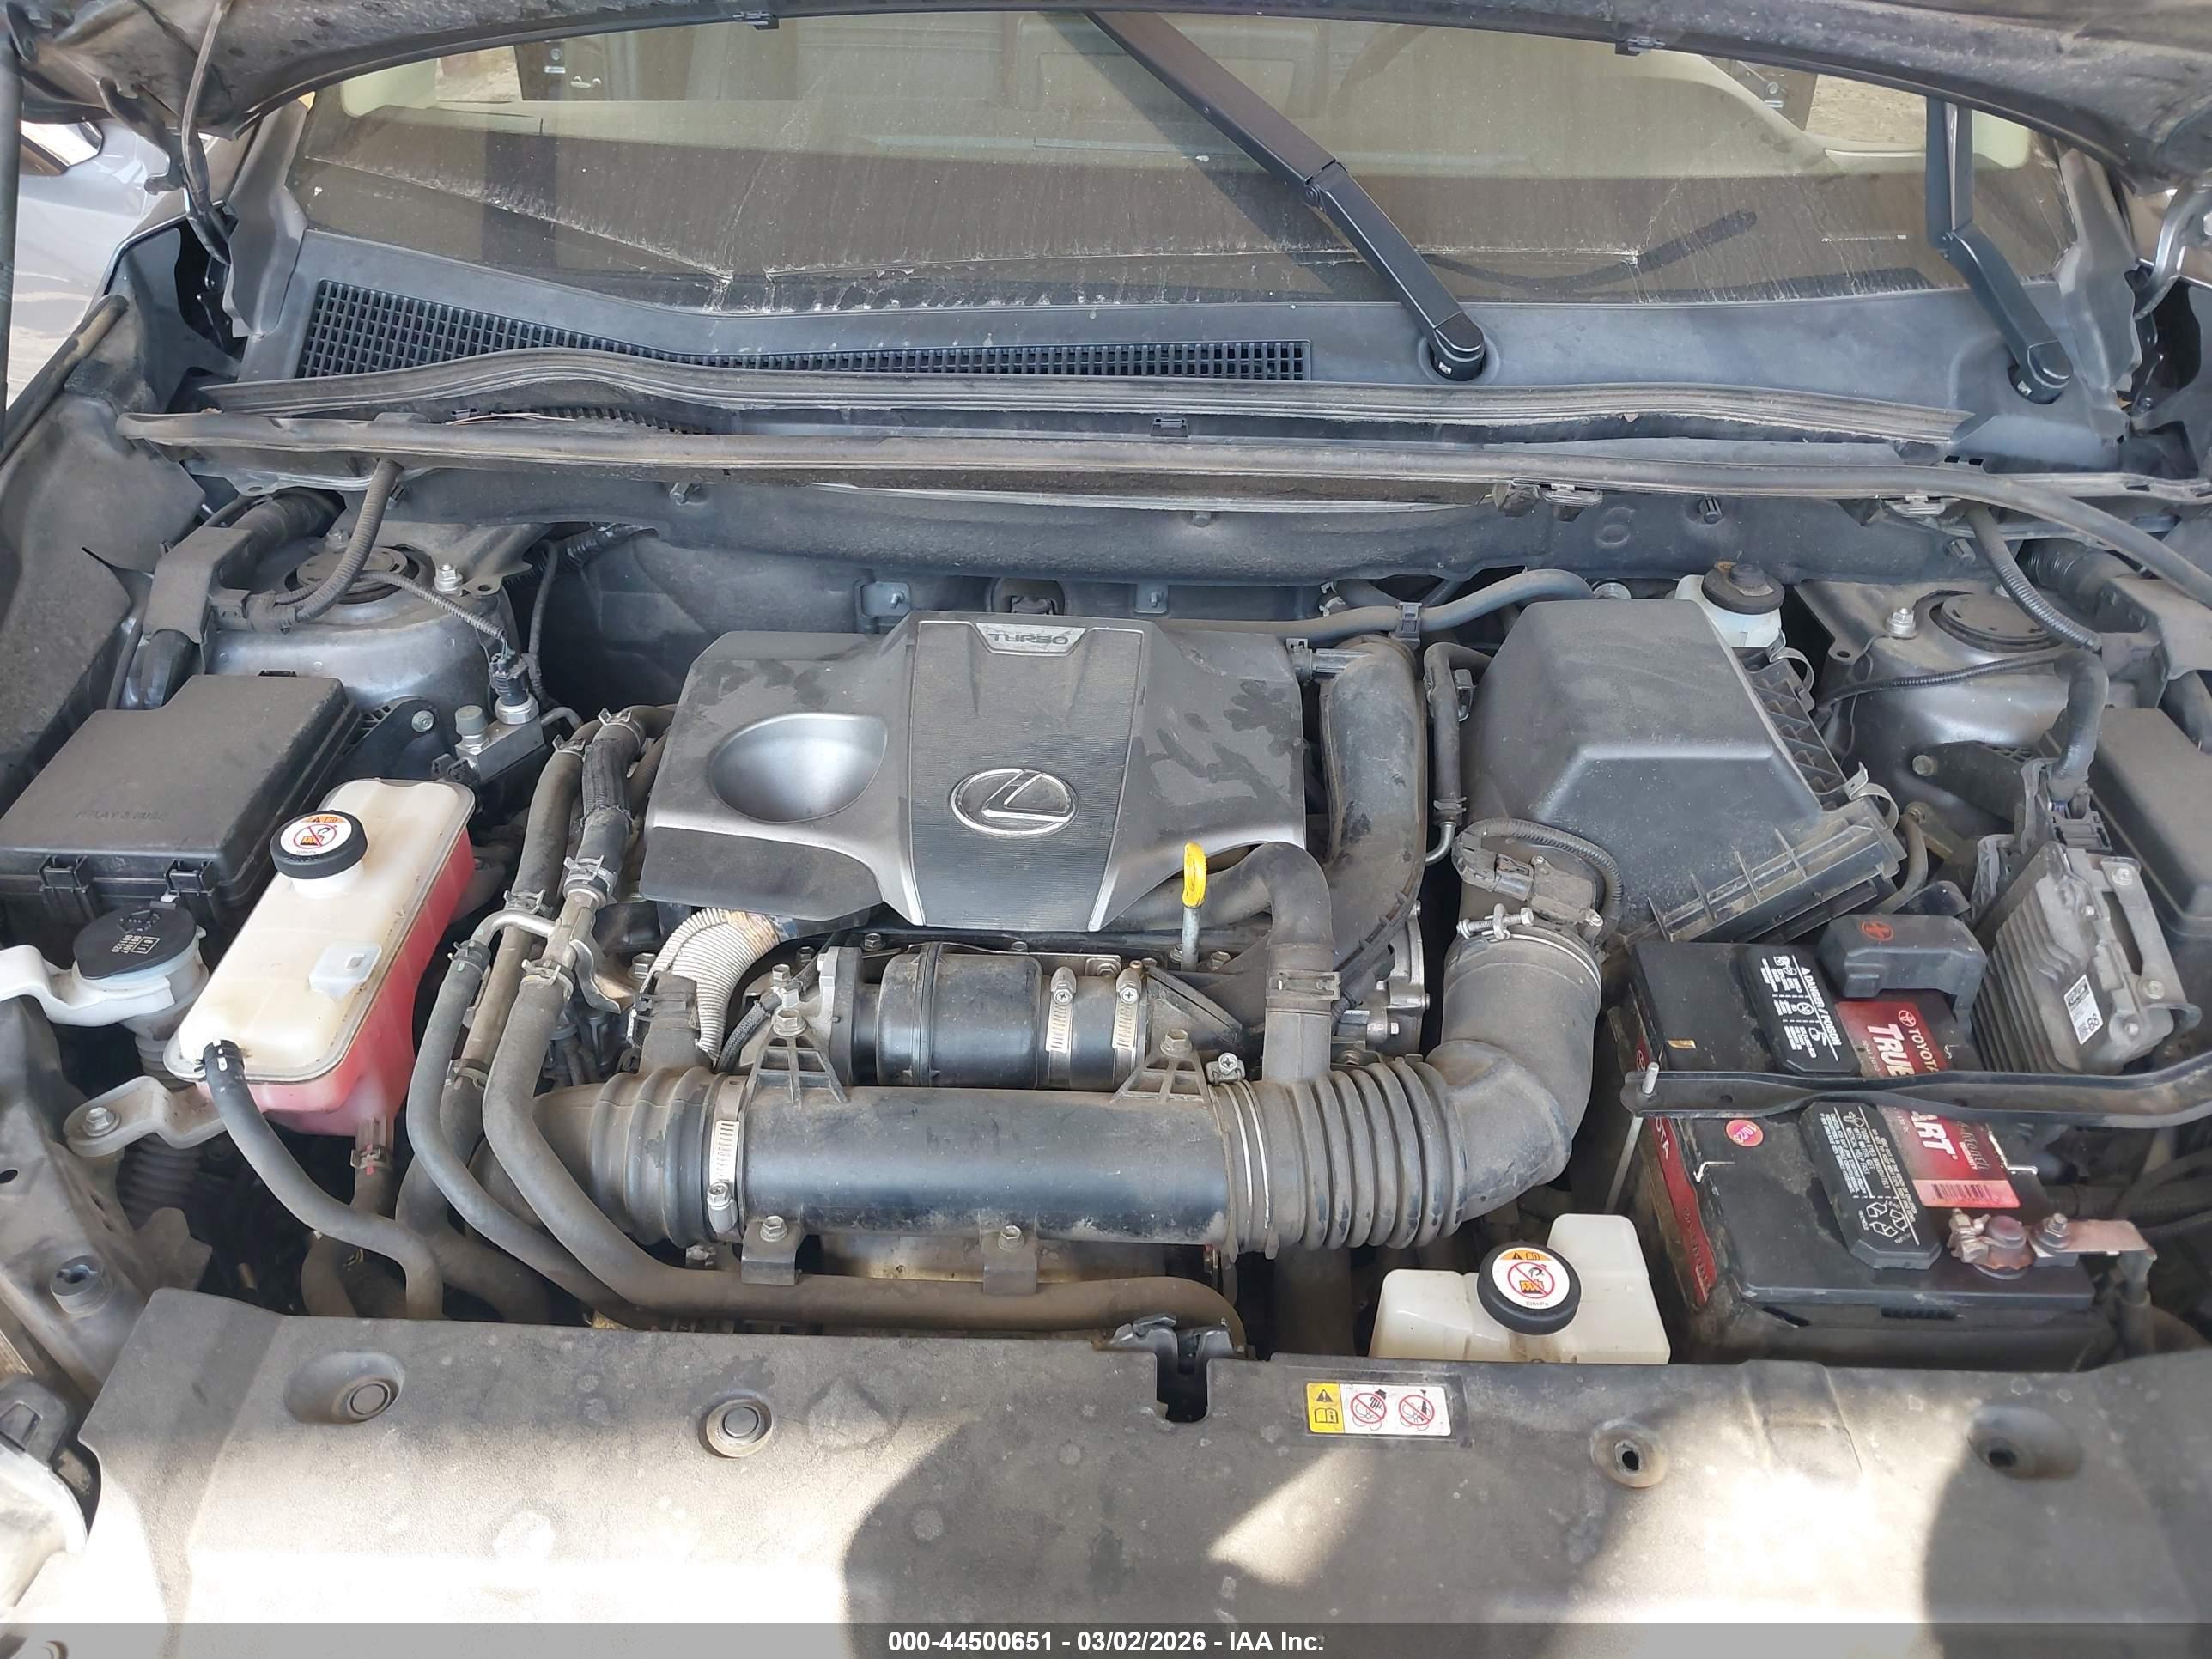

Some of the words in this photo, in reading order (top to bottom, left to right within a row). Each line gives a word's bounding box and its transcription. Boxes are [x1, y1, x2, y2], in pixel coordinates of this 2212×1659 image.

[988, 631, 1070, 646] TURBO
[1804, 975, 1826, 1010] DANGER
[1820, 1015, 1843, 1047] POISON
[1867, 1023, 1916, 1077] TRUE
